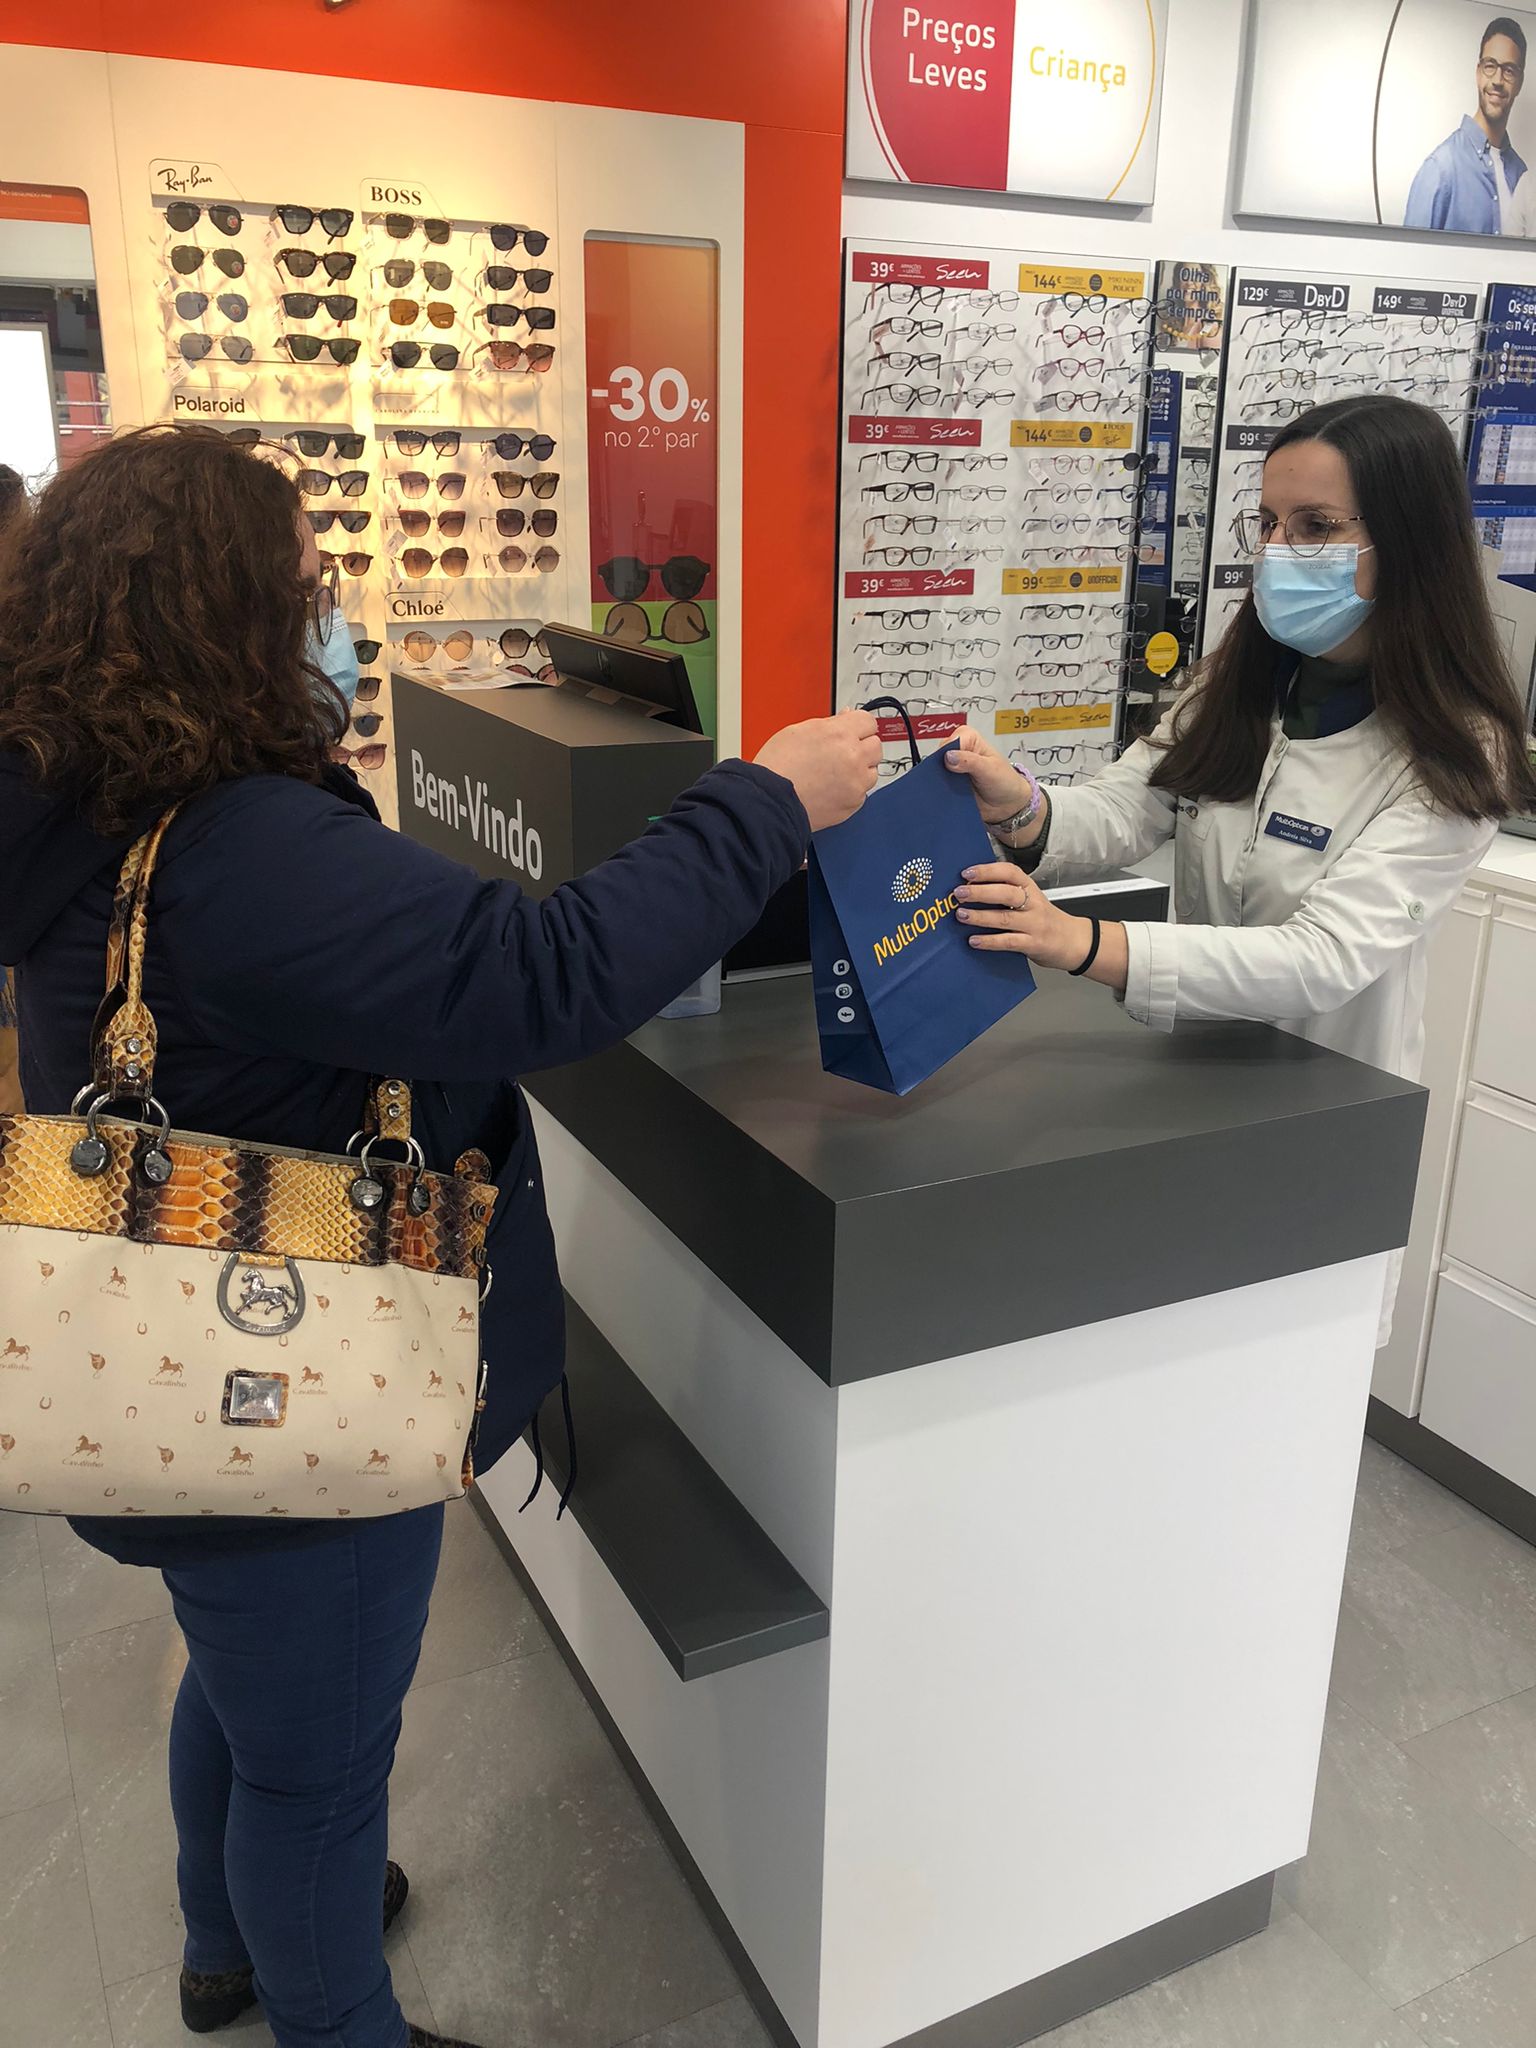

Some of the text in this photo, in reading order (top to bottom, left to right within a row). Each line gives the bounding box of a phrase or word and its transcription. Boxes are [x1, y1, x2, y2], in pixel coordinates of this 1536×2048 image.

[902, 6, 996, 54] Preços
[908, 52, 987, 92] Leves
[1029, 45, 1126, 93] Criança
[370, 185, 422, 206] BOSS
[869, 261, 895, 278] 39€
[936, 263, 981, 281] Seen
[1180, 267, 1210, 283] Olha
[1033, 274, 1062, 289] 144€
[1243, 286, 1270, 301] 129€
[1377, 294, 1402, 309] 149€
[1168, 306, 1216, 322] sempre
[1508, 299, 1522, 314] Os
[1523, 319, 1530, 332] 4
[591, 366, 710, 422] -30%
[175, 395, 245, 413] Polaroid
[865, 424, 890, 438] 39€
[930, 423, 975, 439] Seen
[1025, 428, 1052, 442] 144€
[1239, 432, 1260, 446] 99€
[605, 431, 632, 447] no
[665, 432, 699, 453] par
[861, 579, 884, 592] 39€
[923, 574, 967, 591] Seen
[1022, 576, 1044, 590] 99€
[1224, 571, 1244, 584] 99€
[392, 599, 444, 617] Chloé
[917, 720, 960, 735] Seen
[1014, 715, 1034, 729] 39€
[411, 748, 543, 881] Bem-Vindo
[873, 891, 960, 967] MultiOptic
